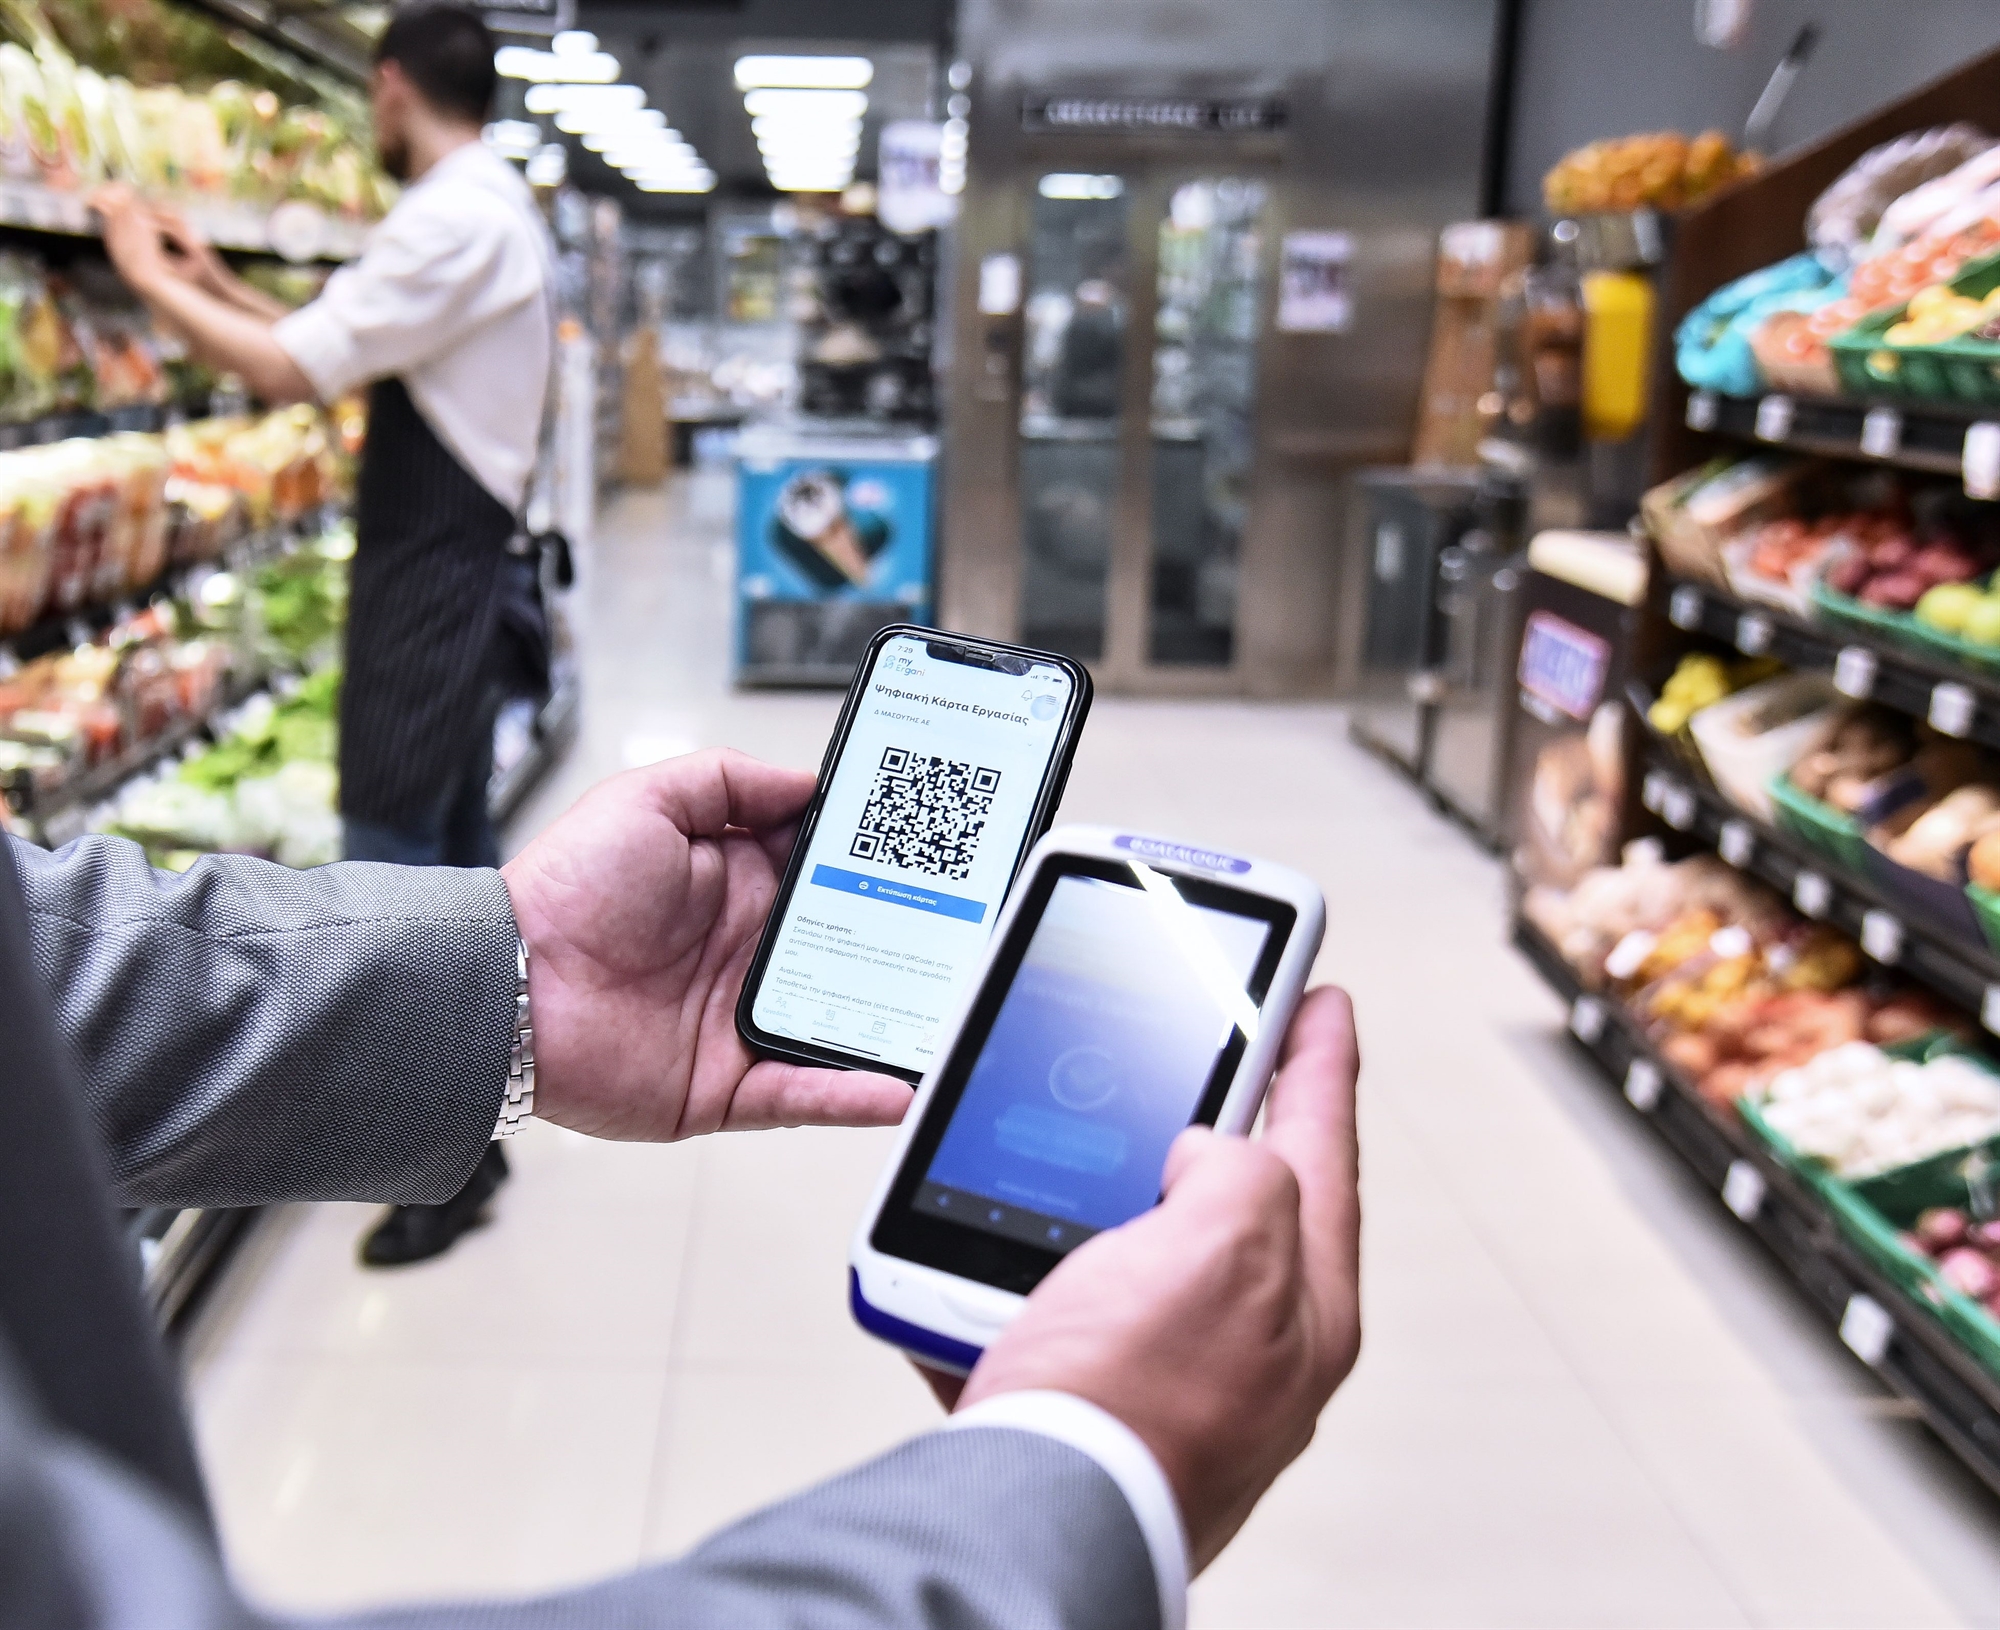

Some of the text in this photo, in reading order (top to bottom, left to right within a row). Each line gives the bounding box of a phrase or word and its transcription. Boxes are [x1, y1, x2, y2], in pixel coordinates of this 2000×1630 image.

[897, 645, 914, 654] 7:29
[896, 664, 925, 676] Ergani
[898, 657, 913, 667] my
[875, 684, 1029, 726] Ψηφιακή Κάρτα Εργασίας
[880, 710, 920, 723] ΜΑΣΟΥΤΗΣ
[877, 886, 937, 906] Εκτύπωση κάρτας
[796, 915, 825, 928] Οδηγίες
[826, 924, 852, 935] χρήσης
[792, 926, 823, 939] Σκανάρω
[837, 938, 865, 950] ψηφιακή
[866, 945, 879, 953] μου
[880, 949, 901, 958] κάρτα
[902, 953, 935, 967] (QRCode)
[936, 962, 953, 971] στην
[825, 947, 858, 960] εφαρμογή
[860, 955, 871, 963] της
[776, 976, 808, 990] Τοποθετώ
[809, 986, 821, 994] την
[851, 998, 872, 1007] κάρτα
